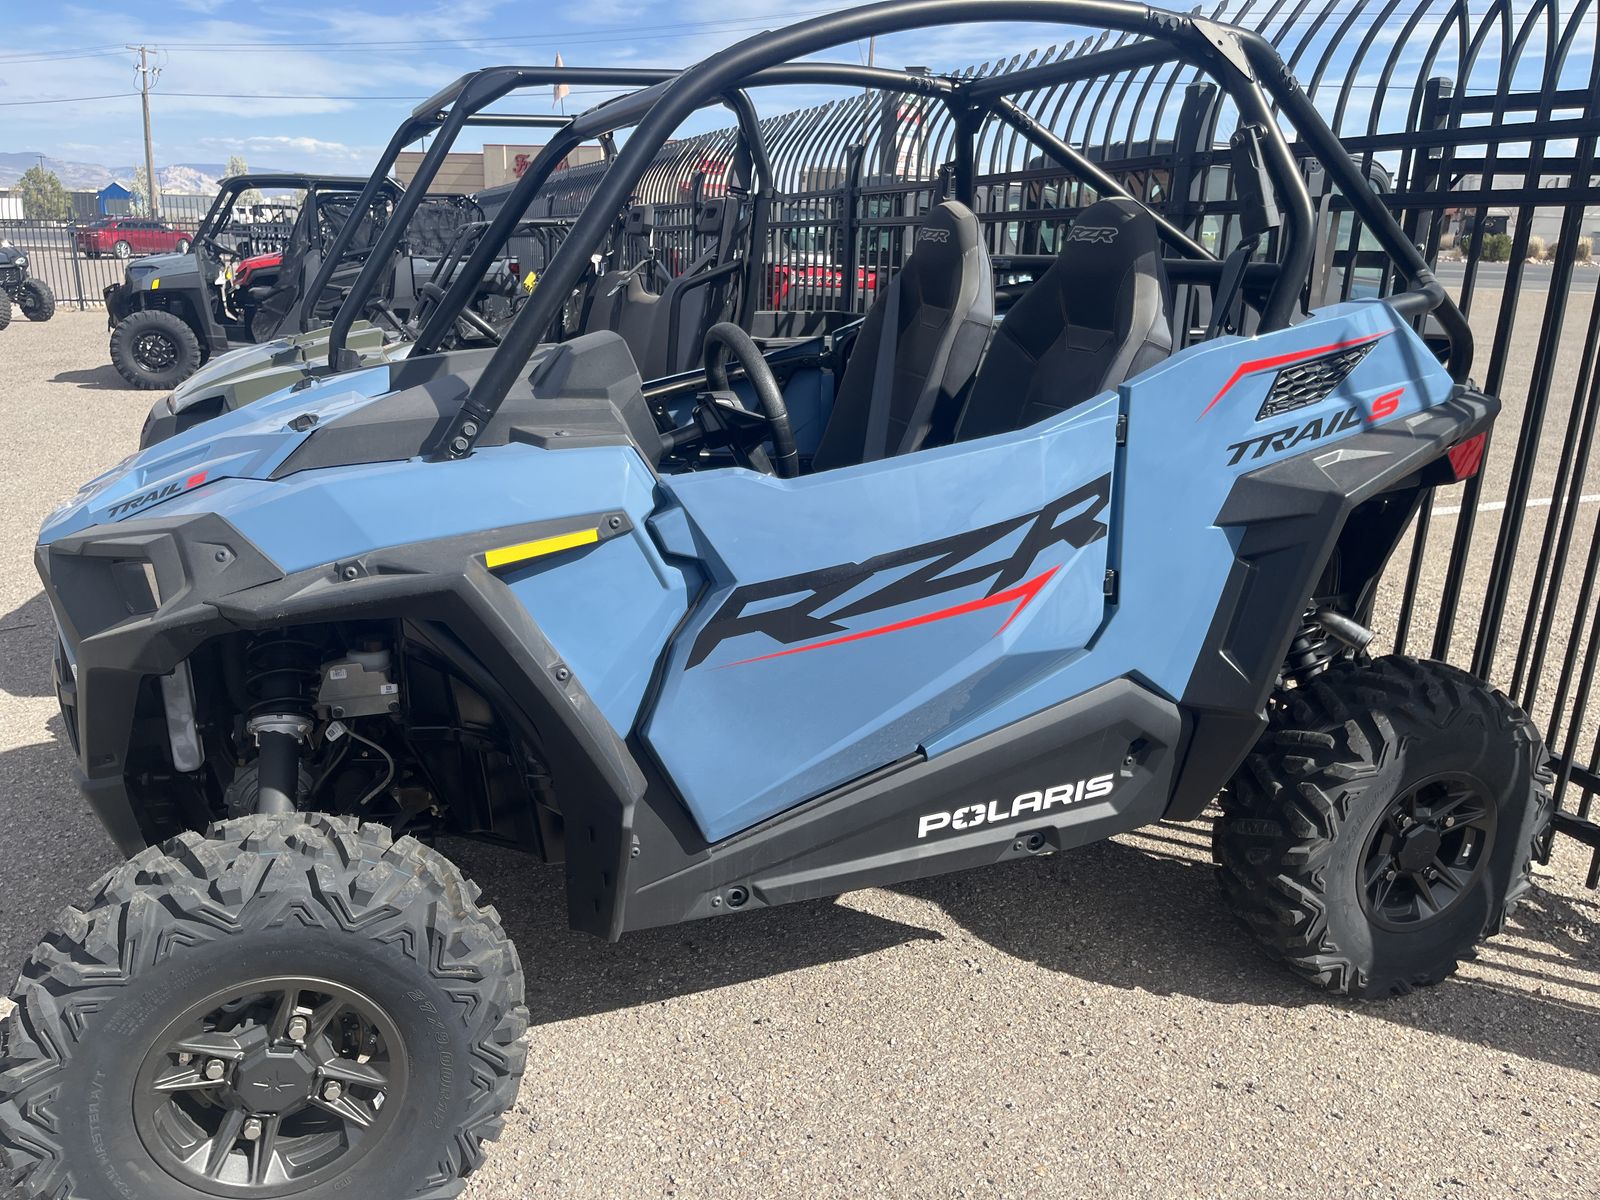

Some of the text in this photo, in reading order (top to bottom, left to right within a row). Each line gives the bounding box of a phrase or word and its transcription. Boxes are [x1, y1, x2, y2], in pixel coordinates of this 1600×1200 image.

[918, 226, 951, 243] RZR
[1066, 226, 1119, 244] RZR
[1226, 387, 1406, 467] TRAIL S
[107, 470, 209, 519] TRAIL S
[684, 471, 1112, 671] RZR
[917, 773, 1114, 839] POLARIS
